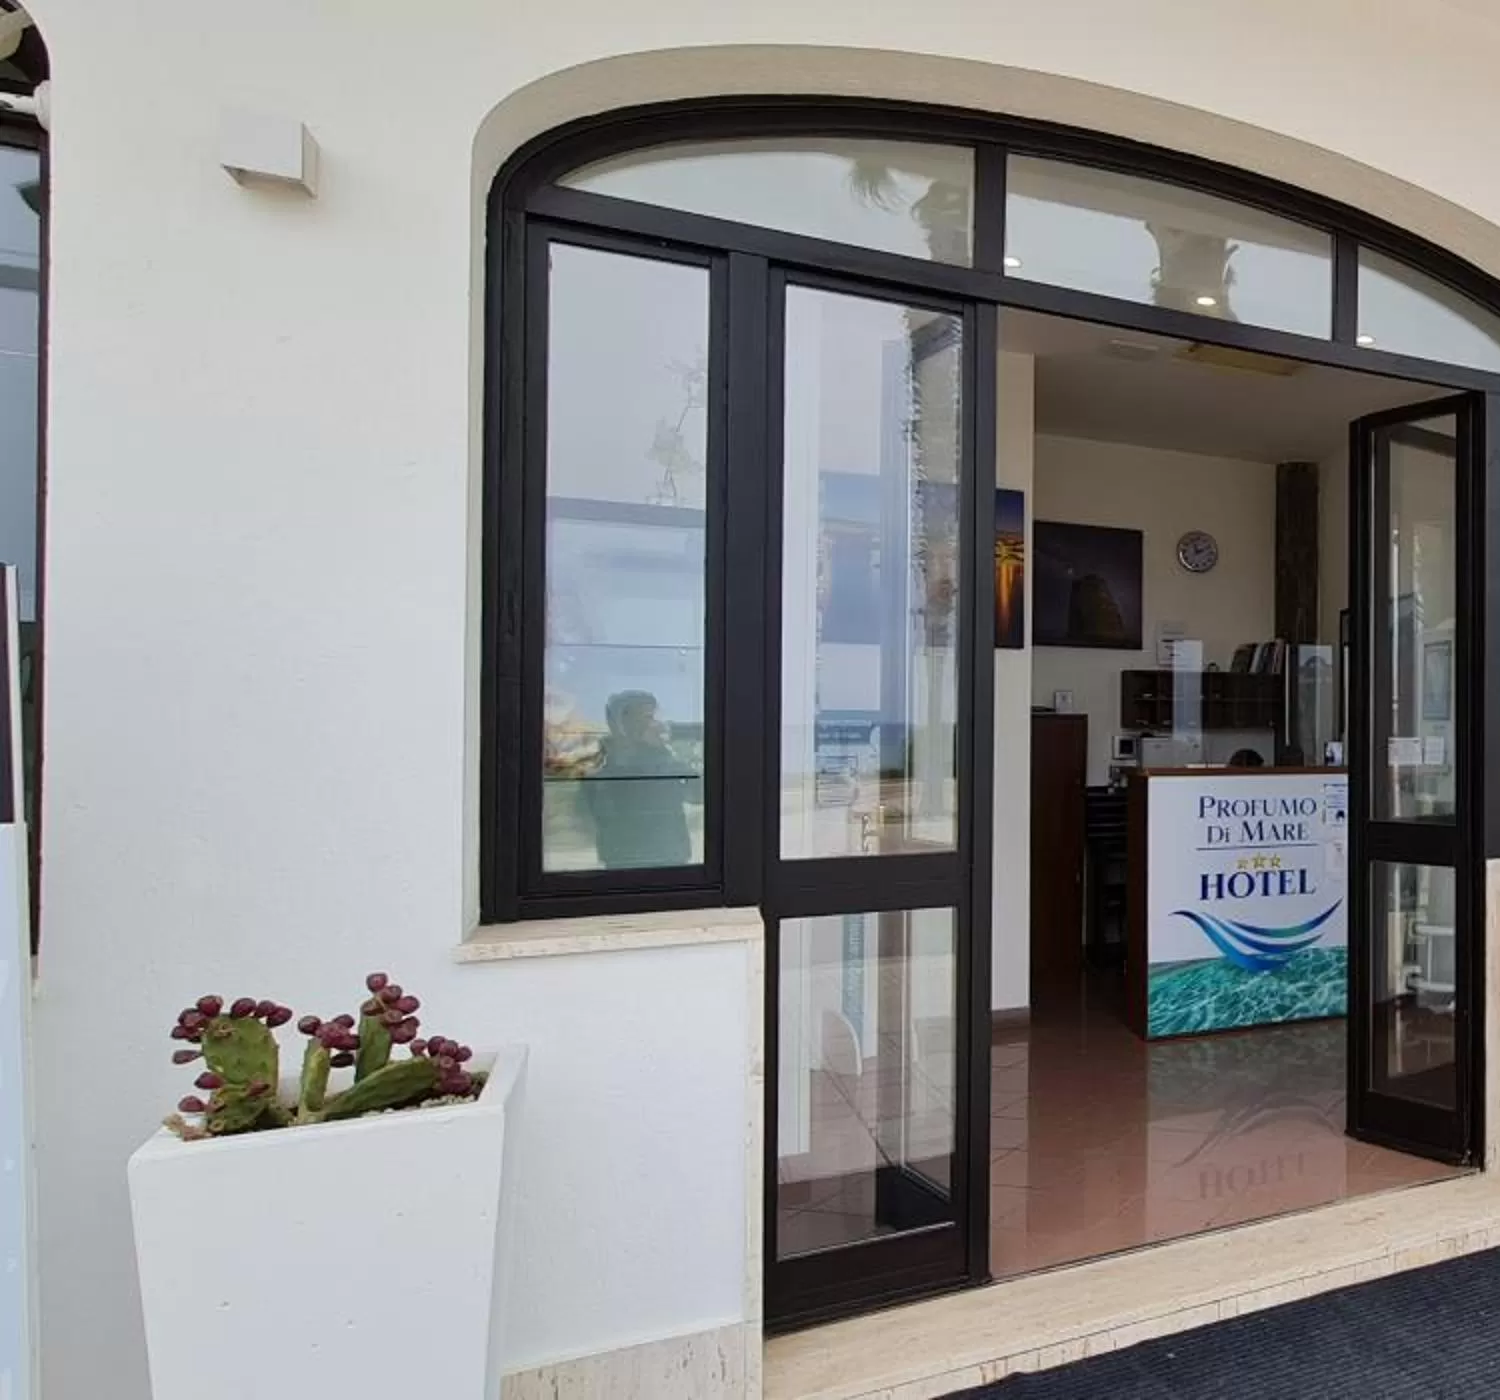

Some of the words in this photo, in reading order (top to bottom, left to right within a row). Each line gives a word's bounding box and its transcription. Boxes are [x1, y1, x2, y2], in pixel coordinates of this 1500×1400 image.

[1198, 795, 1318, 819] PROFUMO
[1239, 819, 1311, 843] MARE
[1199, 868, 1318, 902] HOTEL
